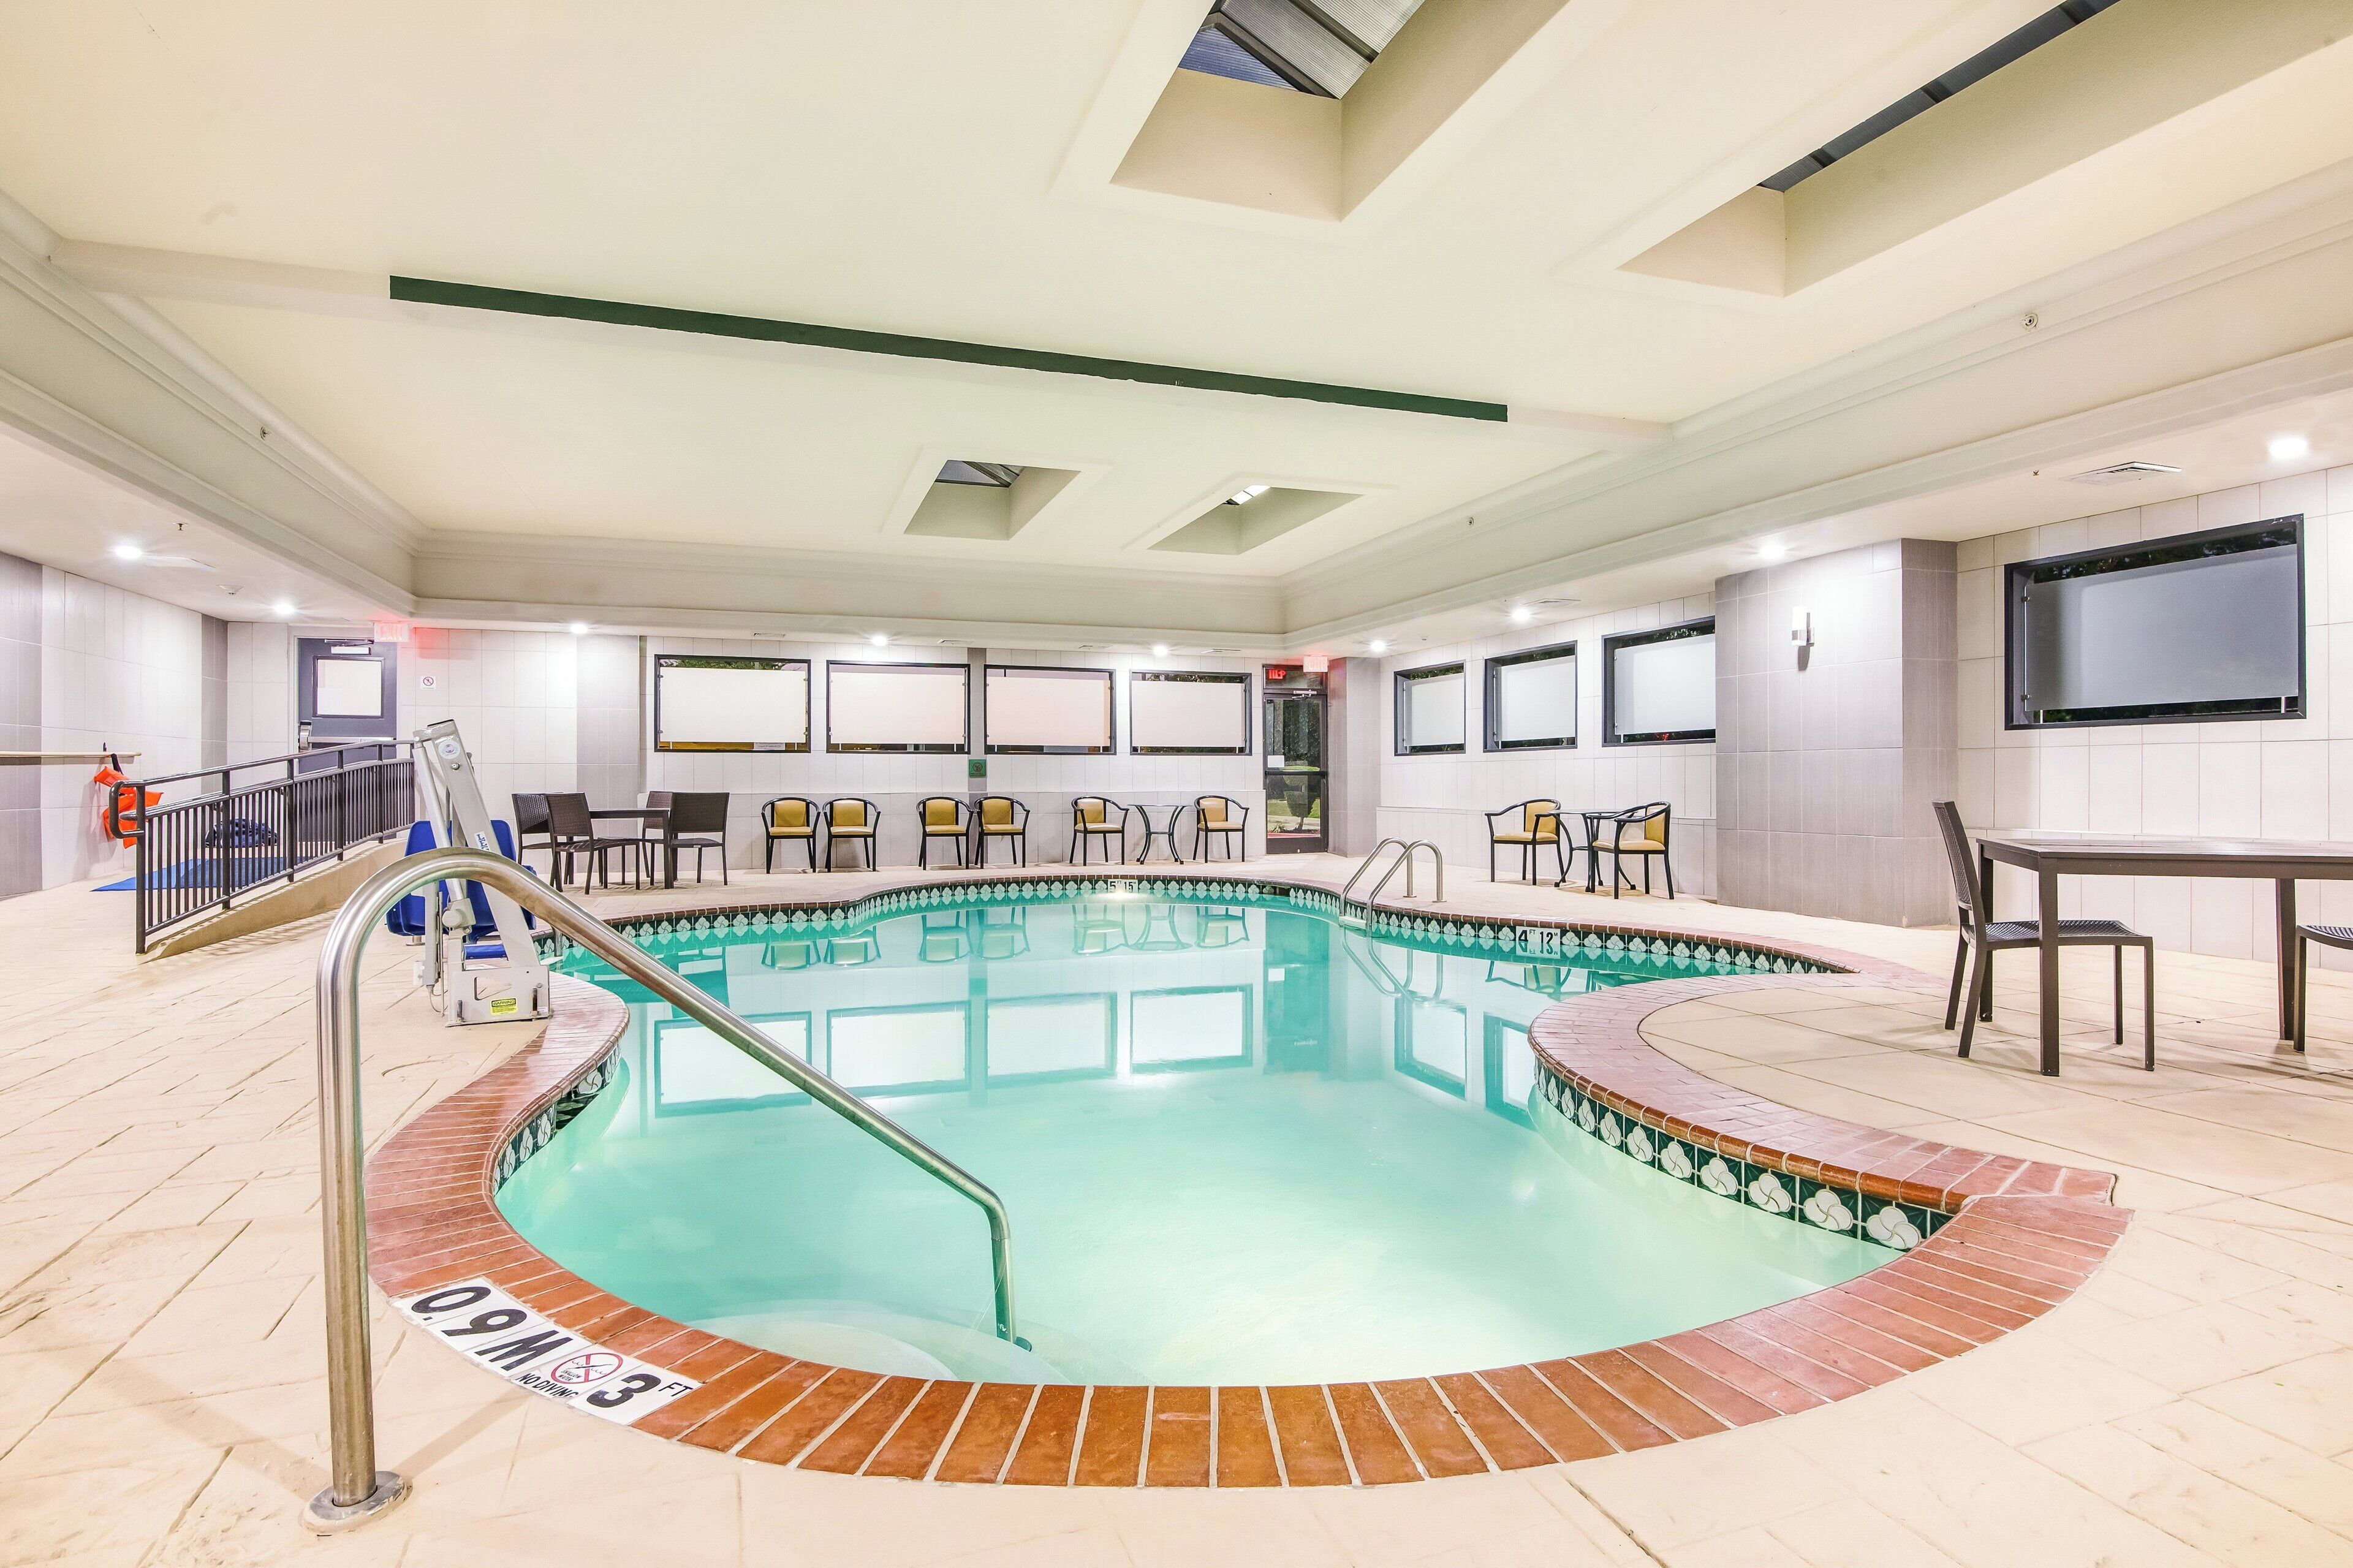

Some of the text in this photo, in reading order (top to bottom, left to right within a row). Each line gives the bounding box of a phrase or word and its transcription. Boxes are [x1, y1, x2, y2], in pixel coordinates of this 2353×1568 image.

[380, 624, 403, 640] EXIT
[1308, 657, 1324, 669] EXIT
[1518, 930, 1528, 942] 4
[515, 1373, 541, 1385] NO
[586, 1373, 693, 1407] 3 FT
